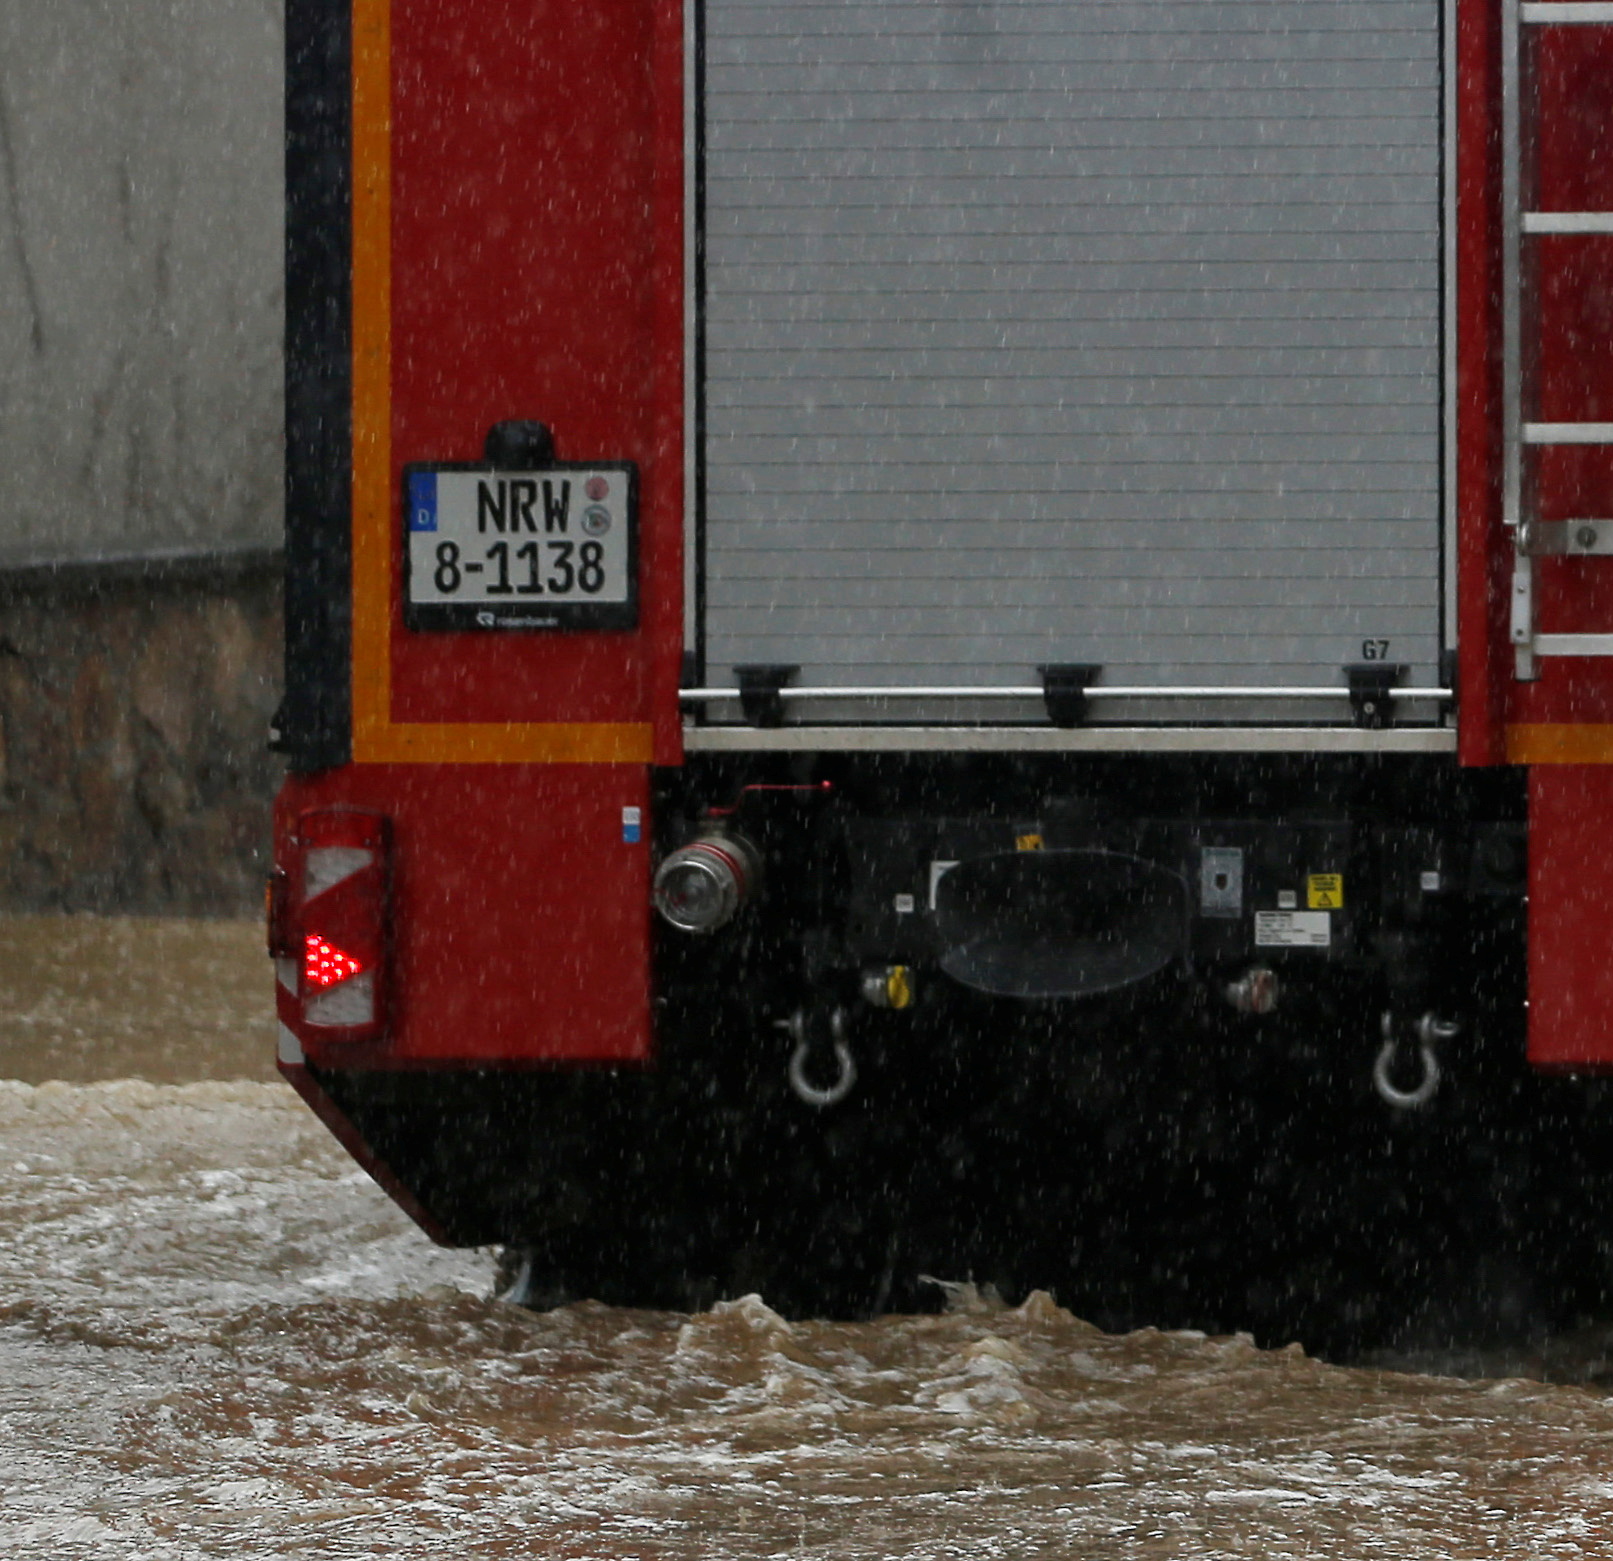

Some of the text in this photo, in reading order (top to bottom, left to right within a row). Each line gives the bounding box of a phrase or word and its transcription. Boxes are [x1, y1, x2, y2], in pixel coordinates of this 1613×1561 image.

[418, 508, 430, 525] D
[477, 479, 571, 533] NRW
[434, 541, 605, 594] 8-1138
[1362, 639, 1390, 660] G7
